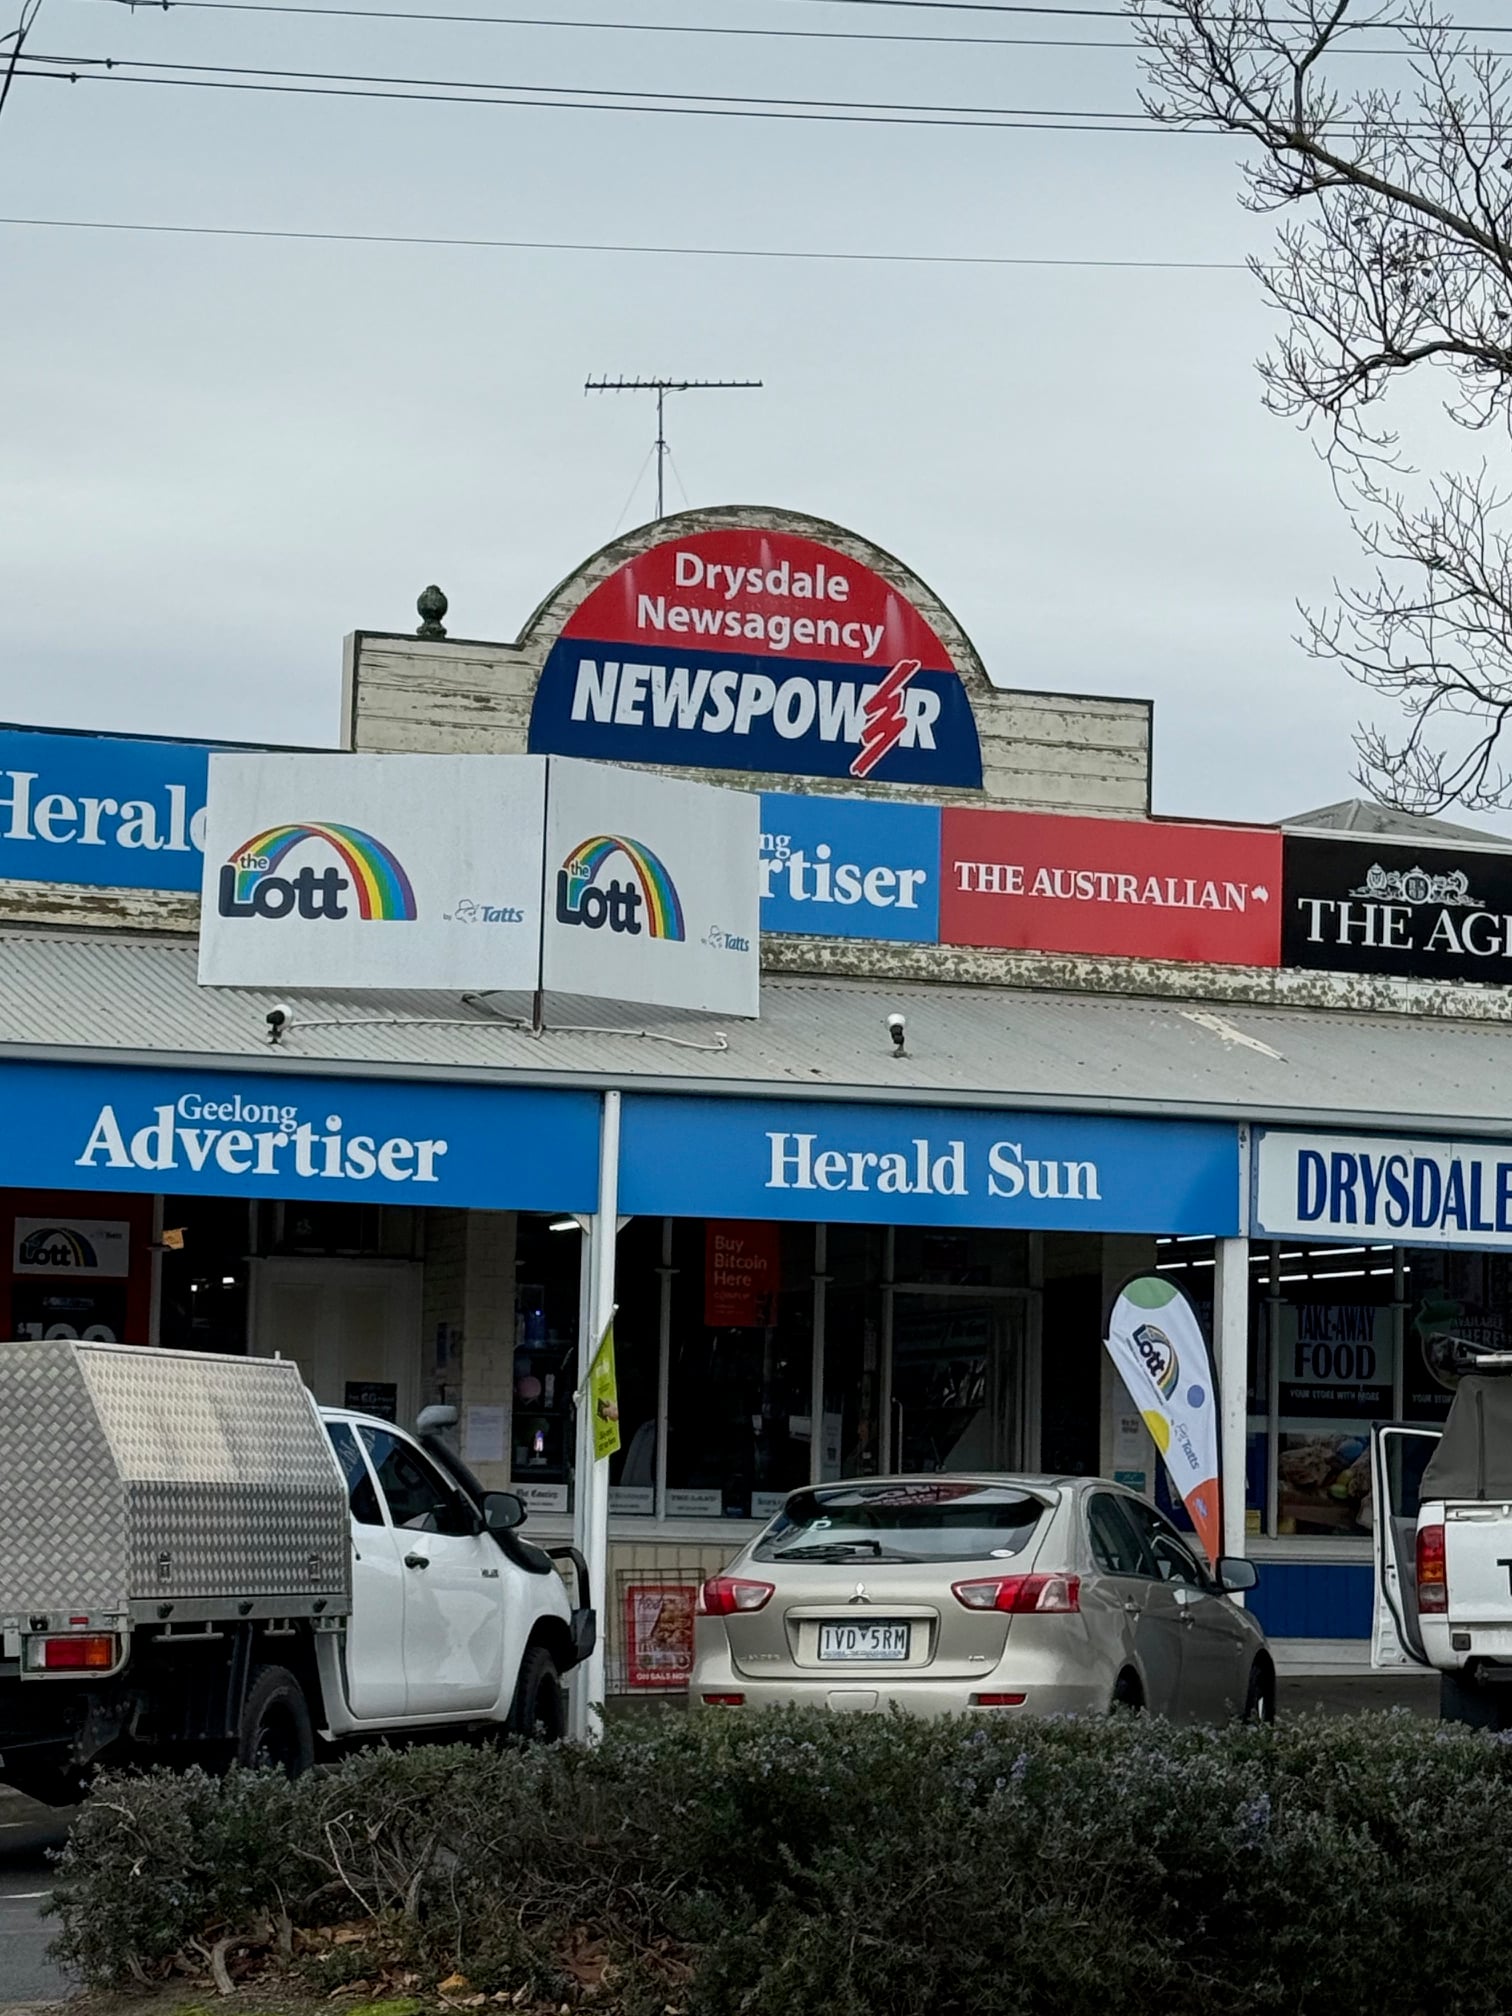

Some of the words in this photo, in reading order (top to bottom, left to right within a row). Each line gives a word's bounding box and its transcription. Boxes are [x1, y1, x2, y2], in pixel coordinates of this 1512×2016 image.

[675, 552, 849, 602] Drysdale
[637, 594, 884, 658] Newsagency
[240, 853, 268, 870] the
[571, 860, 589, 878] the
[218, 864, 349, 920] Lott
[556, 870, 642, 935] Lott
[953, 861, 1025, 895] THE
[1030, 867, 1248, 913] AUSTRALIAN
[480, 905, 524, 923] Tatts
[1297, 897, 1414, 950] THE
[724, 934, 750, 952] Tatts
[177, 1093, 298, 1133] Geelong
[75, 1104, 448, 1182] Advertiser
[764, 1131, 969, 1196] Herald
[987, 1141, 1102, 1200] Sun
[1297, 1149, 1512, 1233] DRYSDALE
[20, 1242, 71, 1266] Lott
[713, 1252, 768, 1271] Bitcoin
[714, 1234, 745, 1254] Buy
[713, 1269, 752, 1287] Here
[1132, 1323, 1166, 1378] Lott
[1294, 1342, 1376, 1379] FOOD
[1289, 1389, 1310, 1399] YOUR
[1181, 1438, 1200, 1471] Tatts
[825, 1629, 856, 1650] 1VD
[871, 1628, 905, 1650] 5RM
